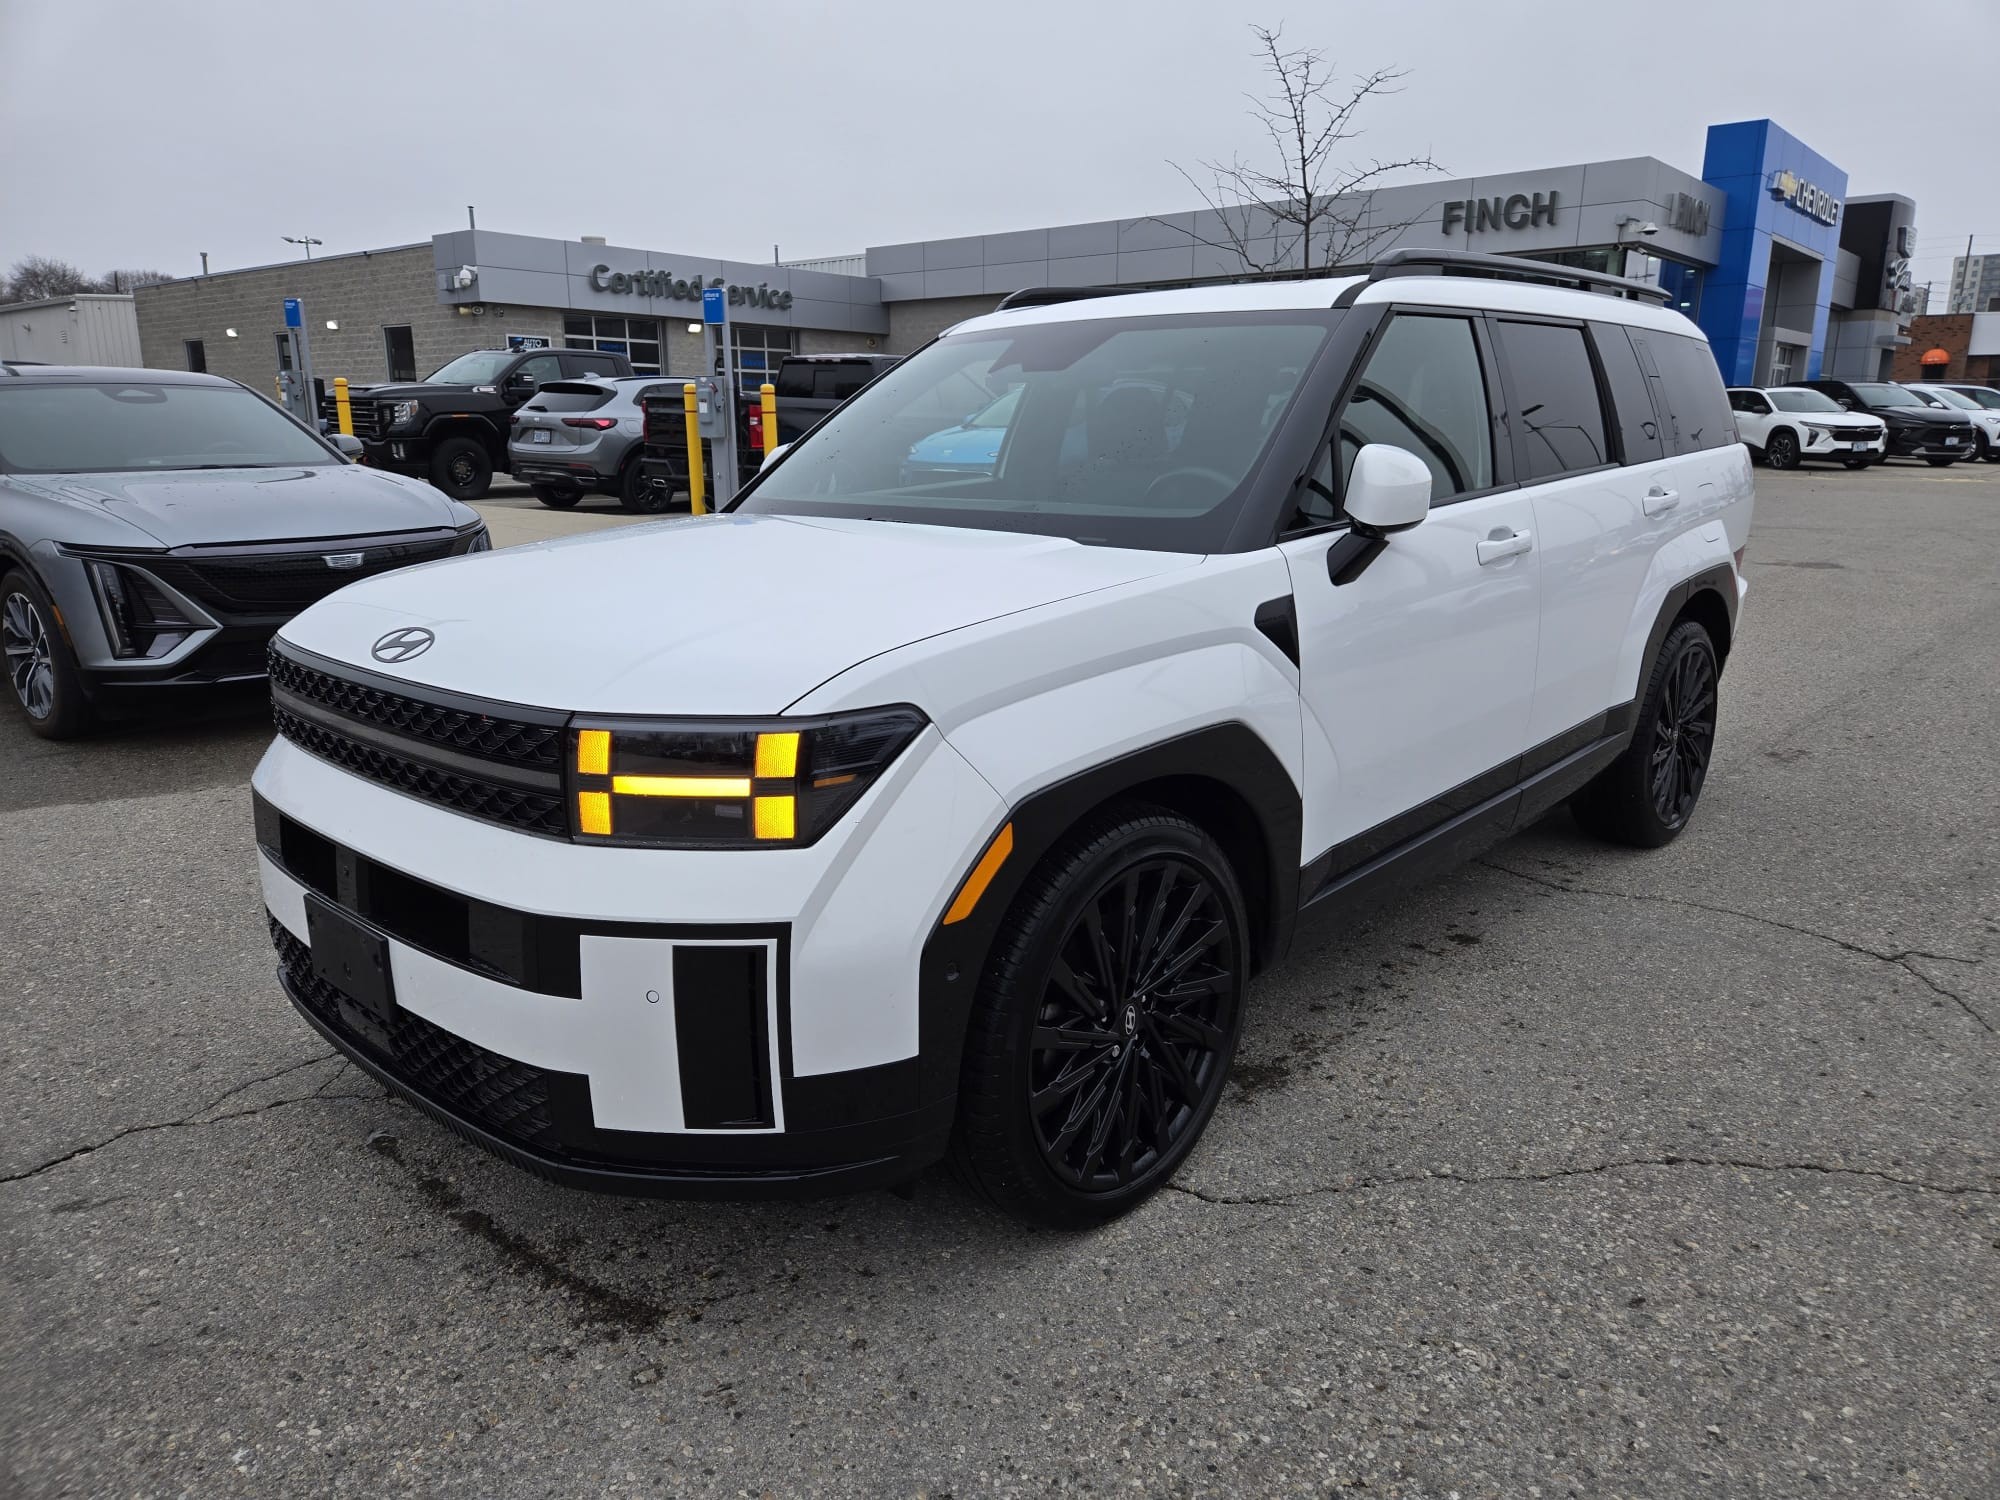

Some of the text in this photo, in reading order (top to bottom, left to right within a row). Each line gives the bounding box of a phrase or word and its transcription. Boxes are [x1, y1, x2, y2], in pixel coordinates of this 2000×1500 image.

[1442, 190, 1560, 236] FINCH
[1796, 178, 1841, 226] CHEVROLET
[590, 264, 703, 302] Certified
